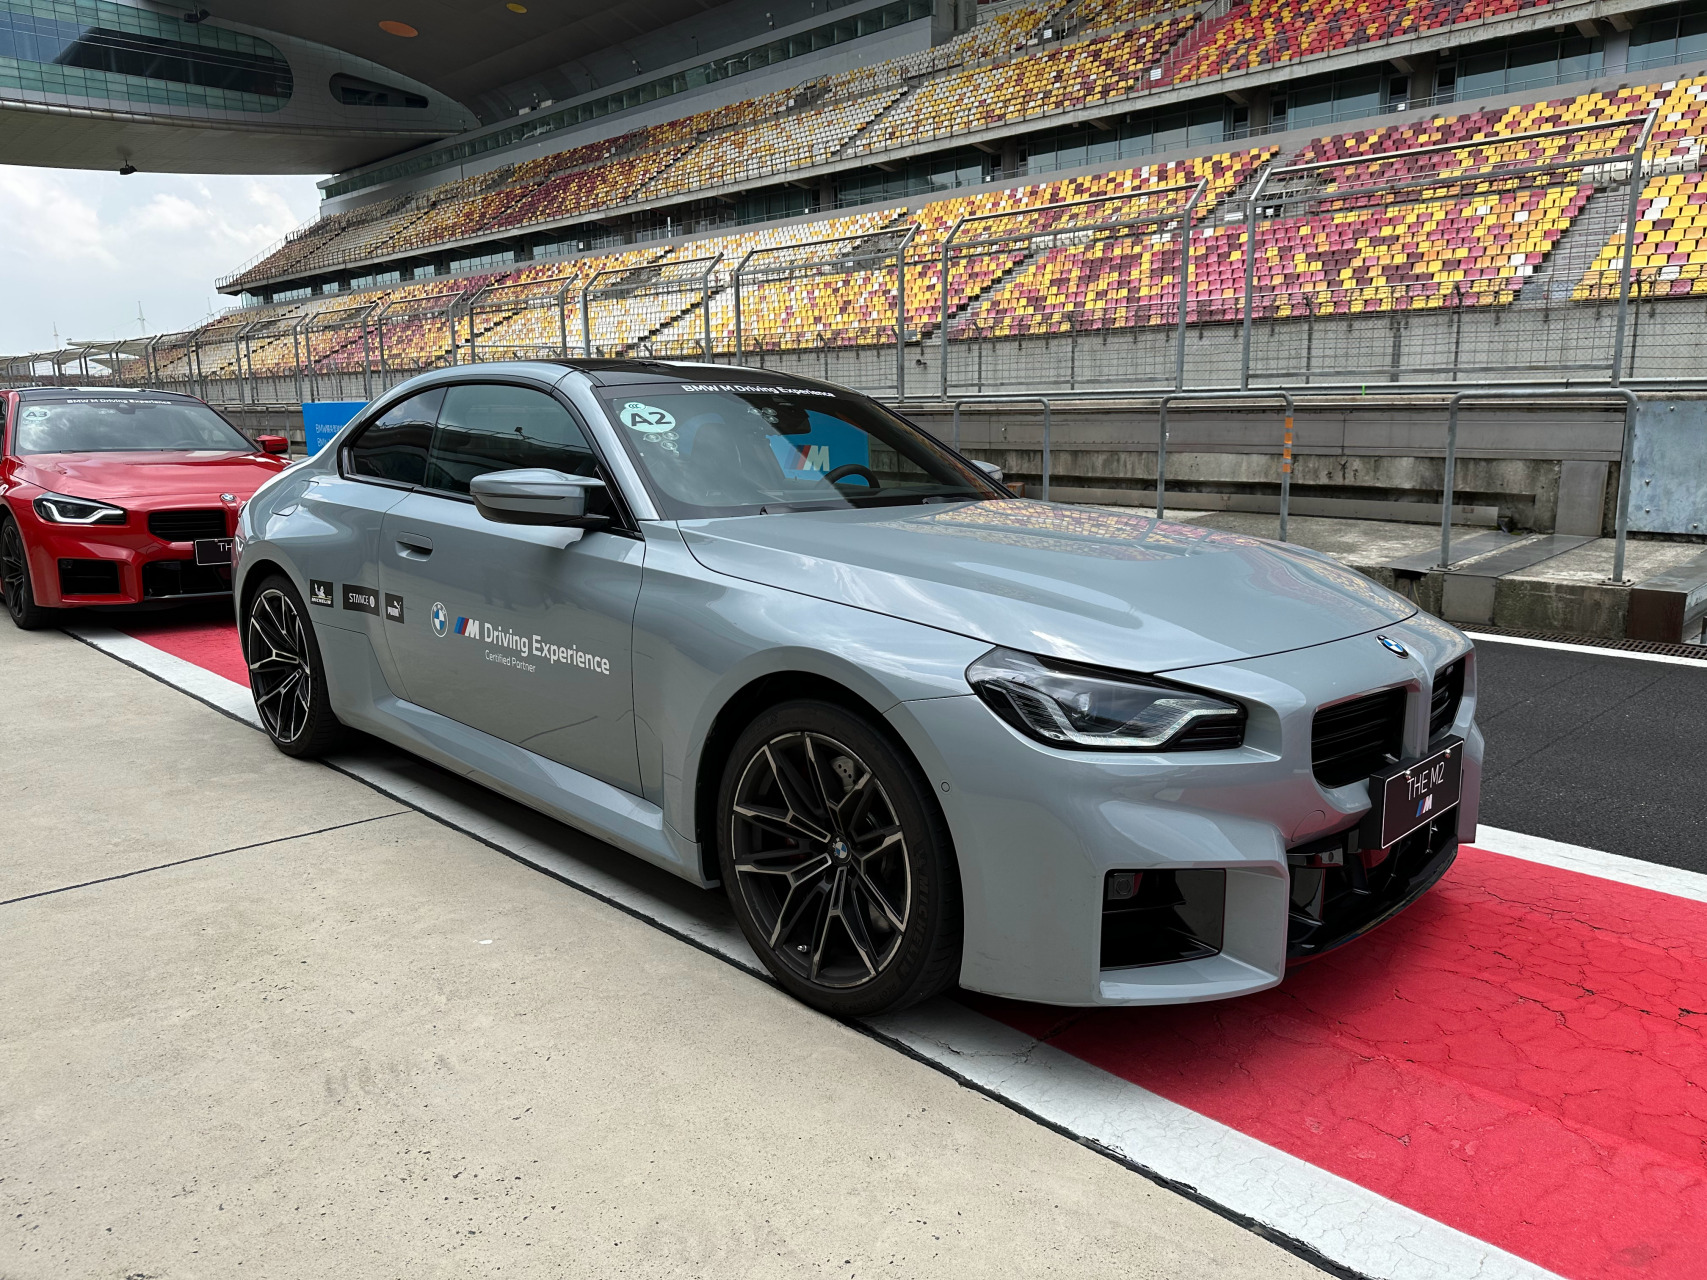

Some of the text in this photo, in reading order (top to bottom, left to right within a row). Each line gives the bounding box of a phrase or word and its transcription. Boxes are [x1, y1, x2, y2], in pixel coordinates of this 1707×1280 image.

[681, 384, 719, 392] BMW
[734, 385, 779, 394] Driving
[776, 386, 836, 398] Experience
[631, 411, 672, 427] A2
[217, 542, 232, 551] TH
[311, 597, 332, 605] MICHELIN
[484, 622, 529, 657] Driving
[532, 635, 610, 675] Experience
[485, 649, 536, 673] Certified Partner
[1407, 761, 1445, 801] THE M2
